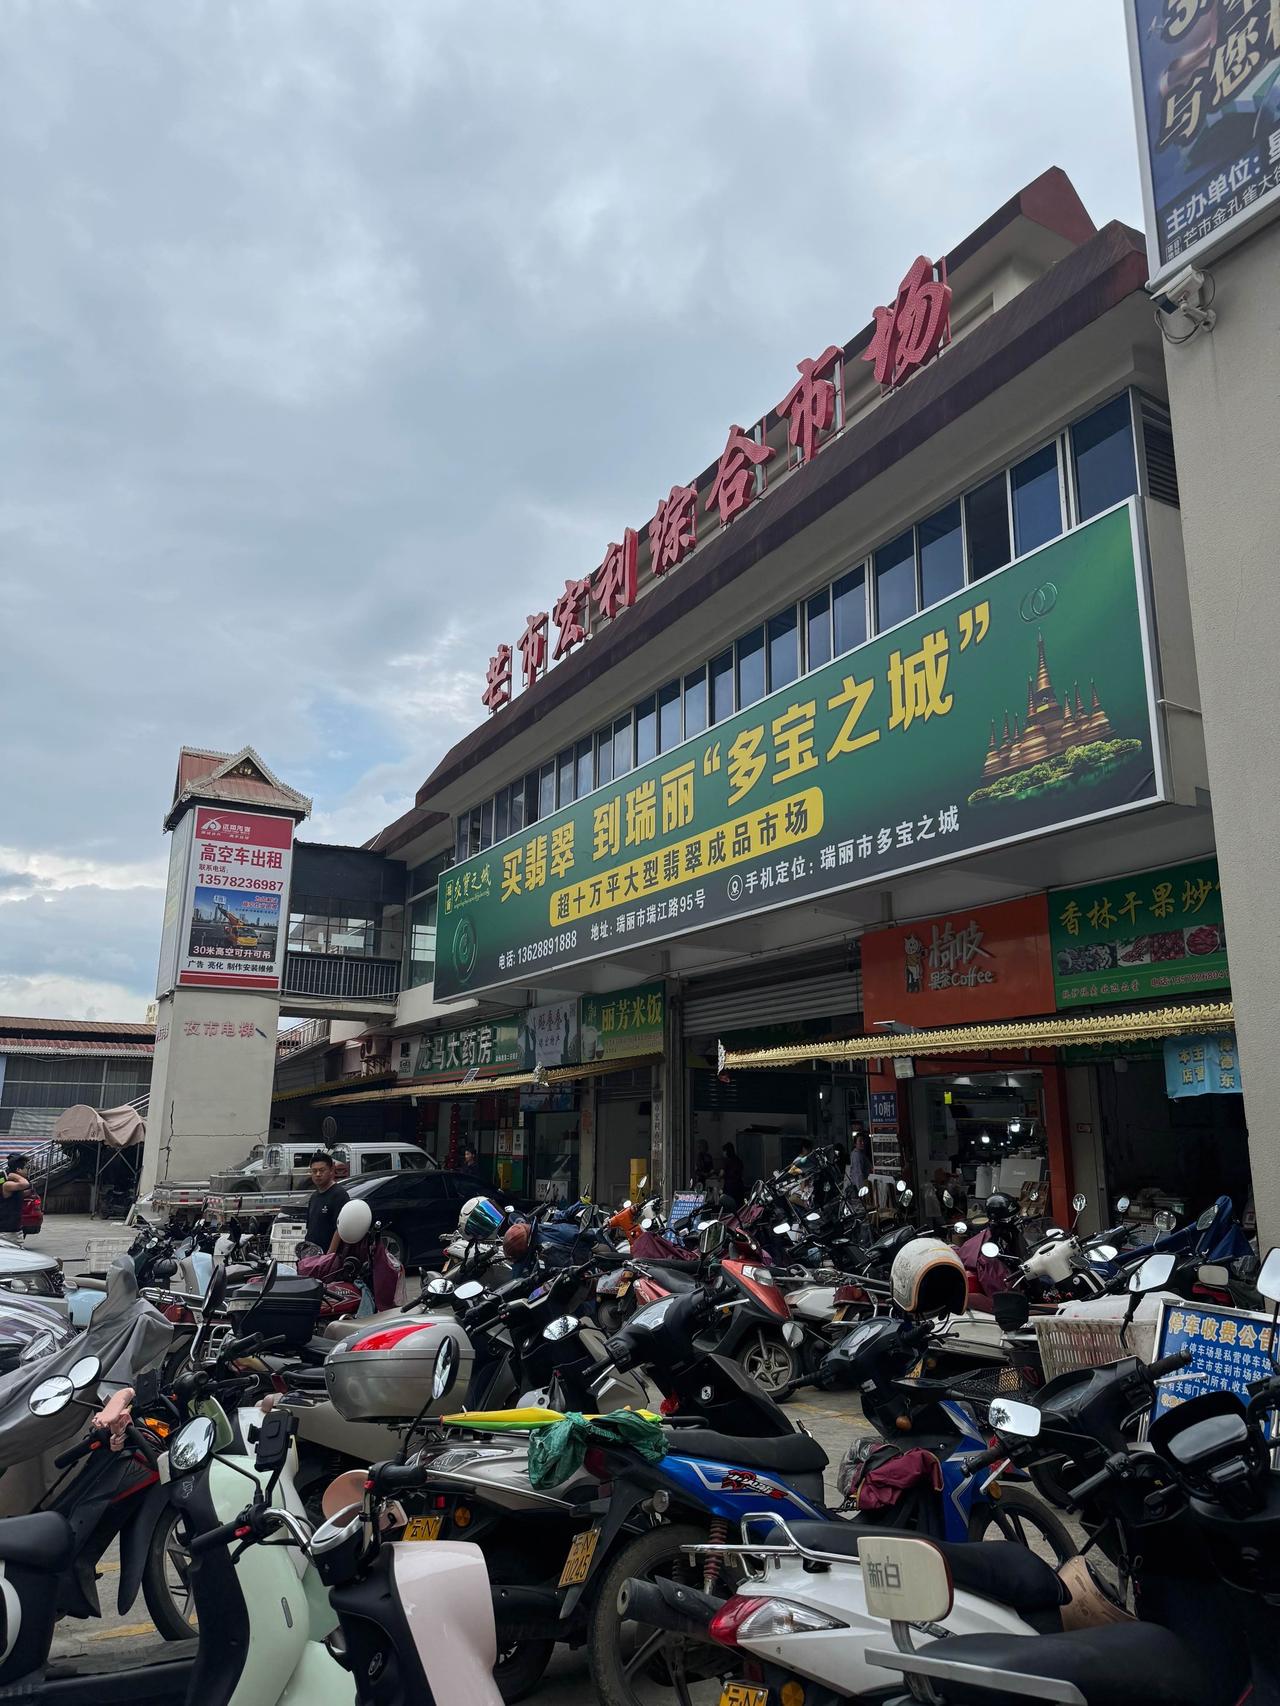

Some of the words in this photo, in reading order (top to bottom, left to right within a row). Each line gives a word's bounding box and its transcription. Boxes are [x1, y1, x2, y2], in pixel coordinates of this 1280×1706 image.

[482, 255, 952, 711] 芒市宏利综合市场
[201, 843, 282, 869] 高空车出租
[501, 820, 576, 902] 买翡翠
[557, 799, 808, 919] 超十万平大型翡翠成品市场
[198, 873, 284, 892] 13578236987
[1059, 878, 1221, 936] 香林干果炒
[187, 960, 204, 969] 广告
[192, 945, 271, 959] 30米高空可升可吊
[1169, 1311, 1277, 1353] 停车收费公告
